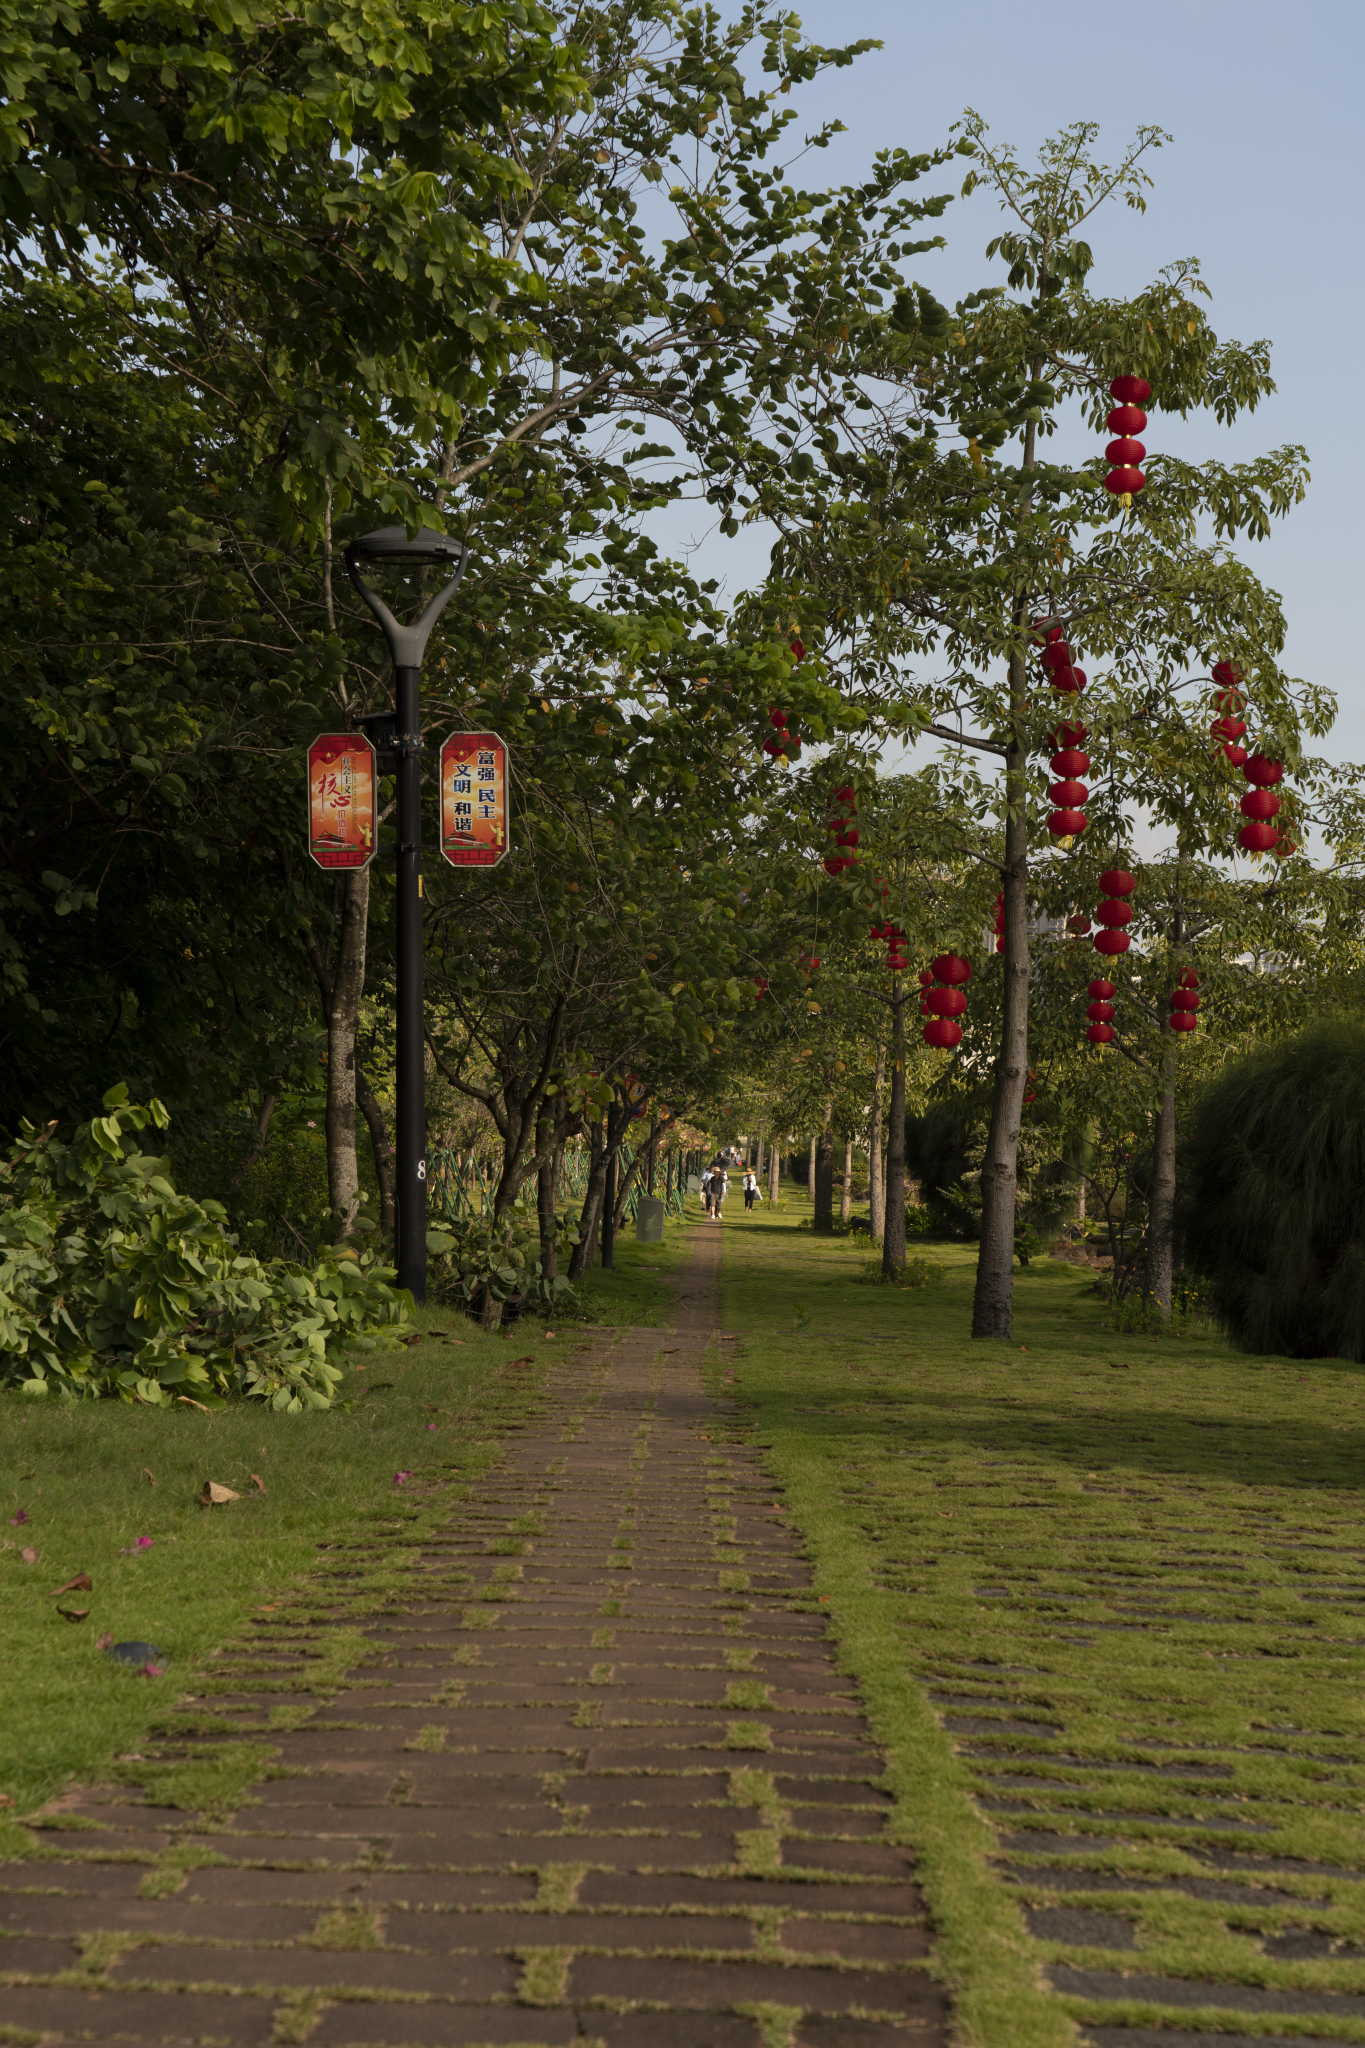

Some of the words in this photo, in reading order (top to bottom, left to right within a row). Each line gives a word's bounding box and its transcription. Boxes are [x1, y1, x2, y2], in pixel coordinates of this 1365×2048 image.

[341, 756, 351, 794] 社会主义
[453, 764, 472, 793] 文明
[478, 752, 496, 781] 富强
[318, 772, 352, 816] 核心
[478, 788, 496, 818] 民主
[454, 802, 472, 831] 和谐
[417, 1160, 426, 1180] 8
